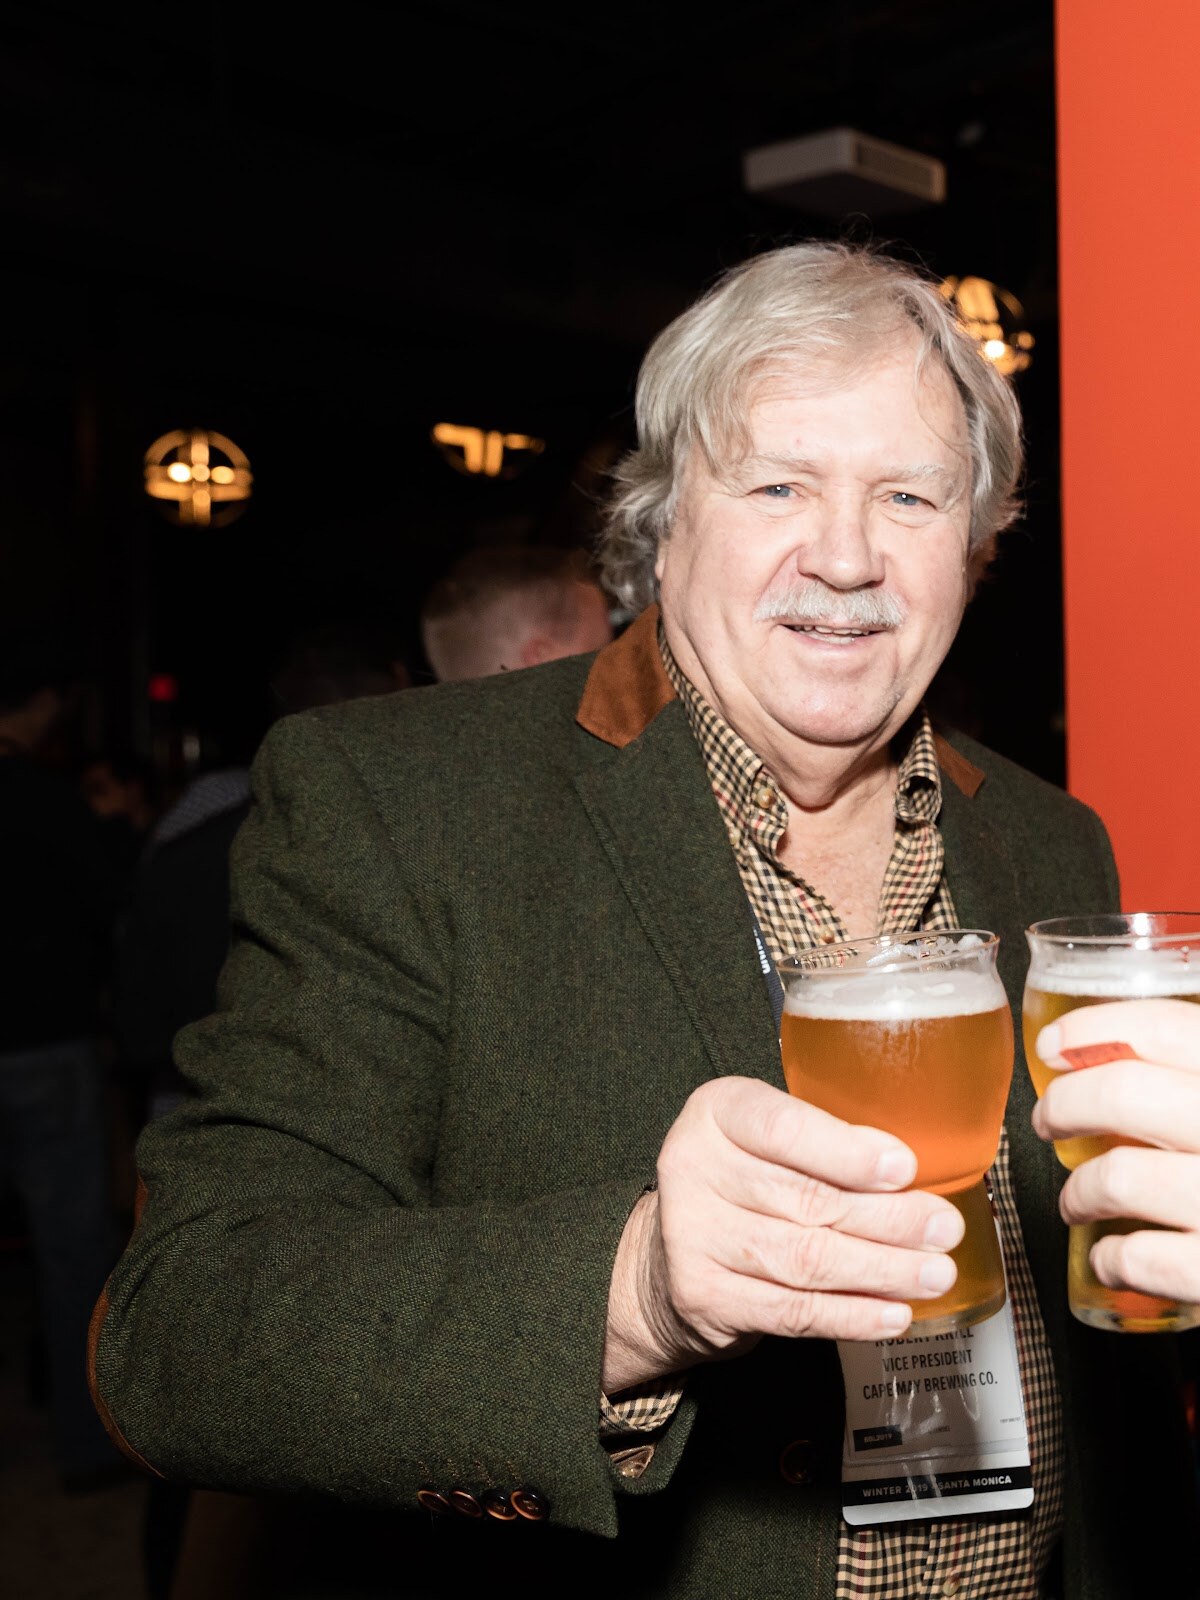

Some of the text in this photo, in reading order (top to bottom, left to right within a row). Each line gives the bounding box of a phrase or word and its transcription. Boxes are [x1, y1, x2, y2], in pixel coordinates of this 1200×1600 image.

[883, 1349, 973, 1373] VICE PRESIDENT
[863, 1371, 998, 1401] CAPE MAY BREWING CO.
[862, 1474, 1013, 1498] WINTER 2019 SANTA MONICA
